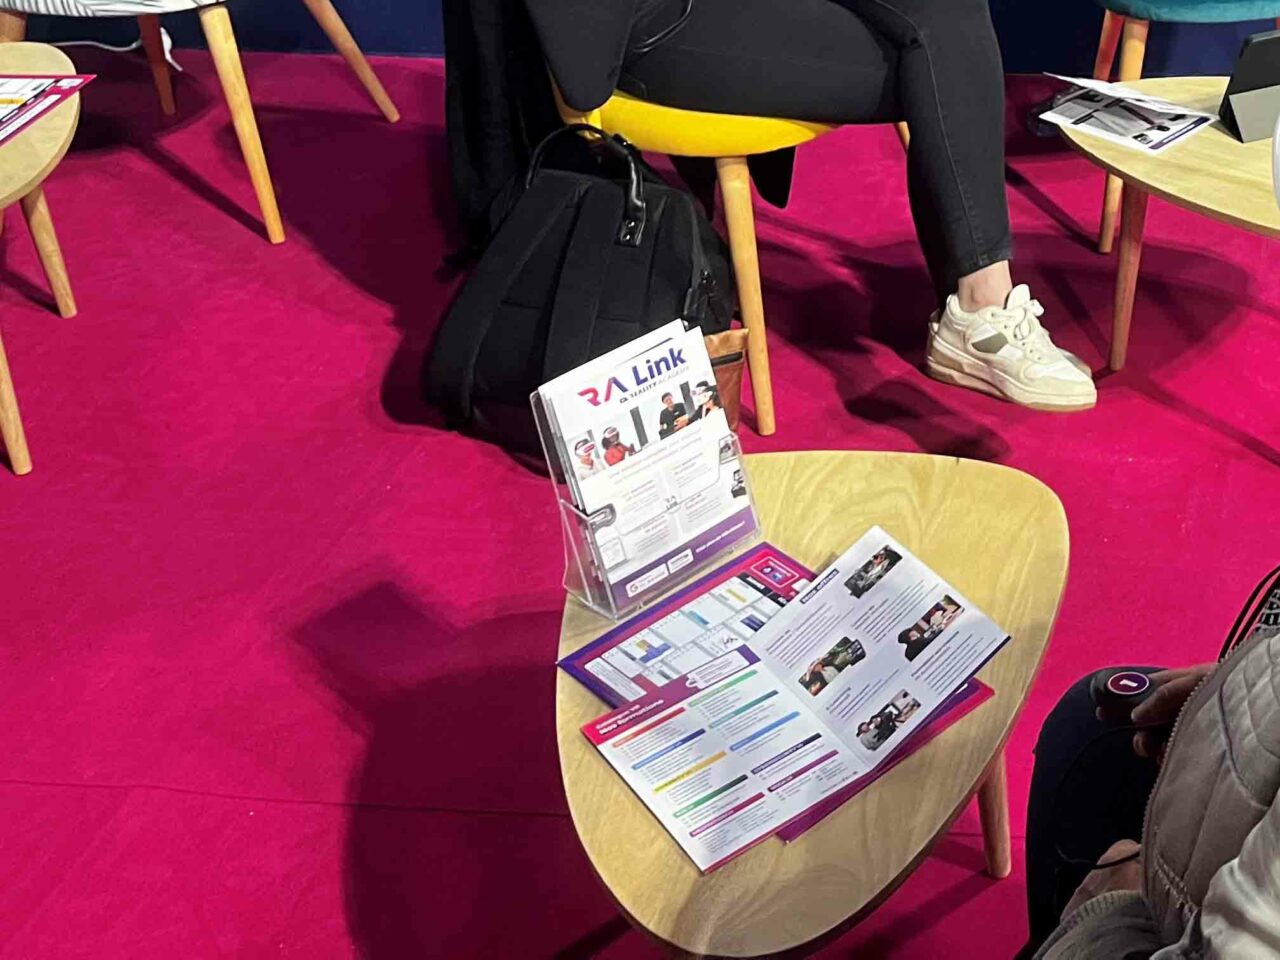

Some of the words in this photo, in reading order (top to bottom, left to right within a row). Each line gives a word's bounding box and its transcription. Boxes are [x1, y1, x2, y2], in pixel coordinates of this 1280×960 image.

[577, 376, 629, 407] RA
[631, 347, 687, 387] Link
[1119, 679, 1138, 687] 1
[617, 699, 664, 725] formations
